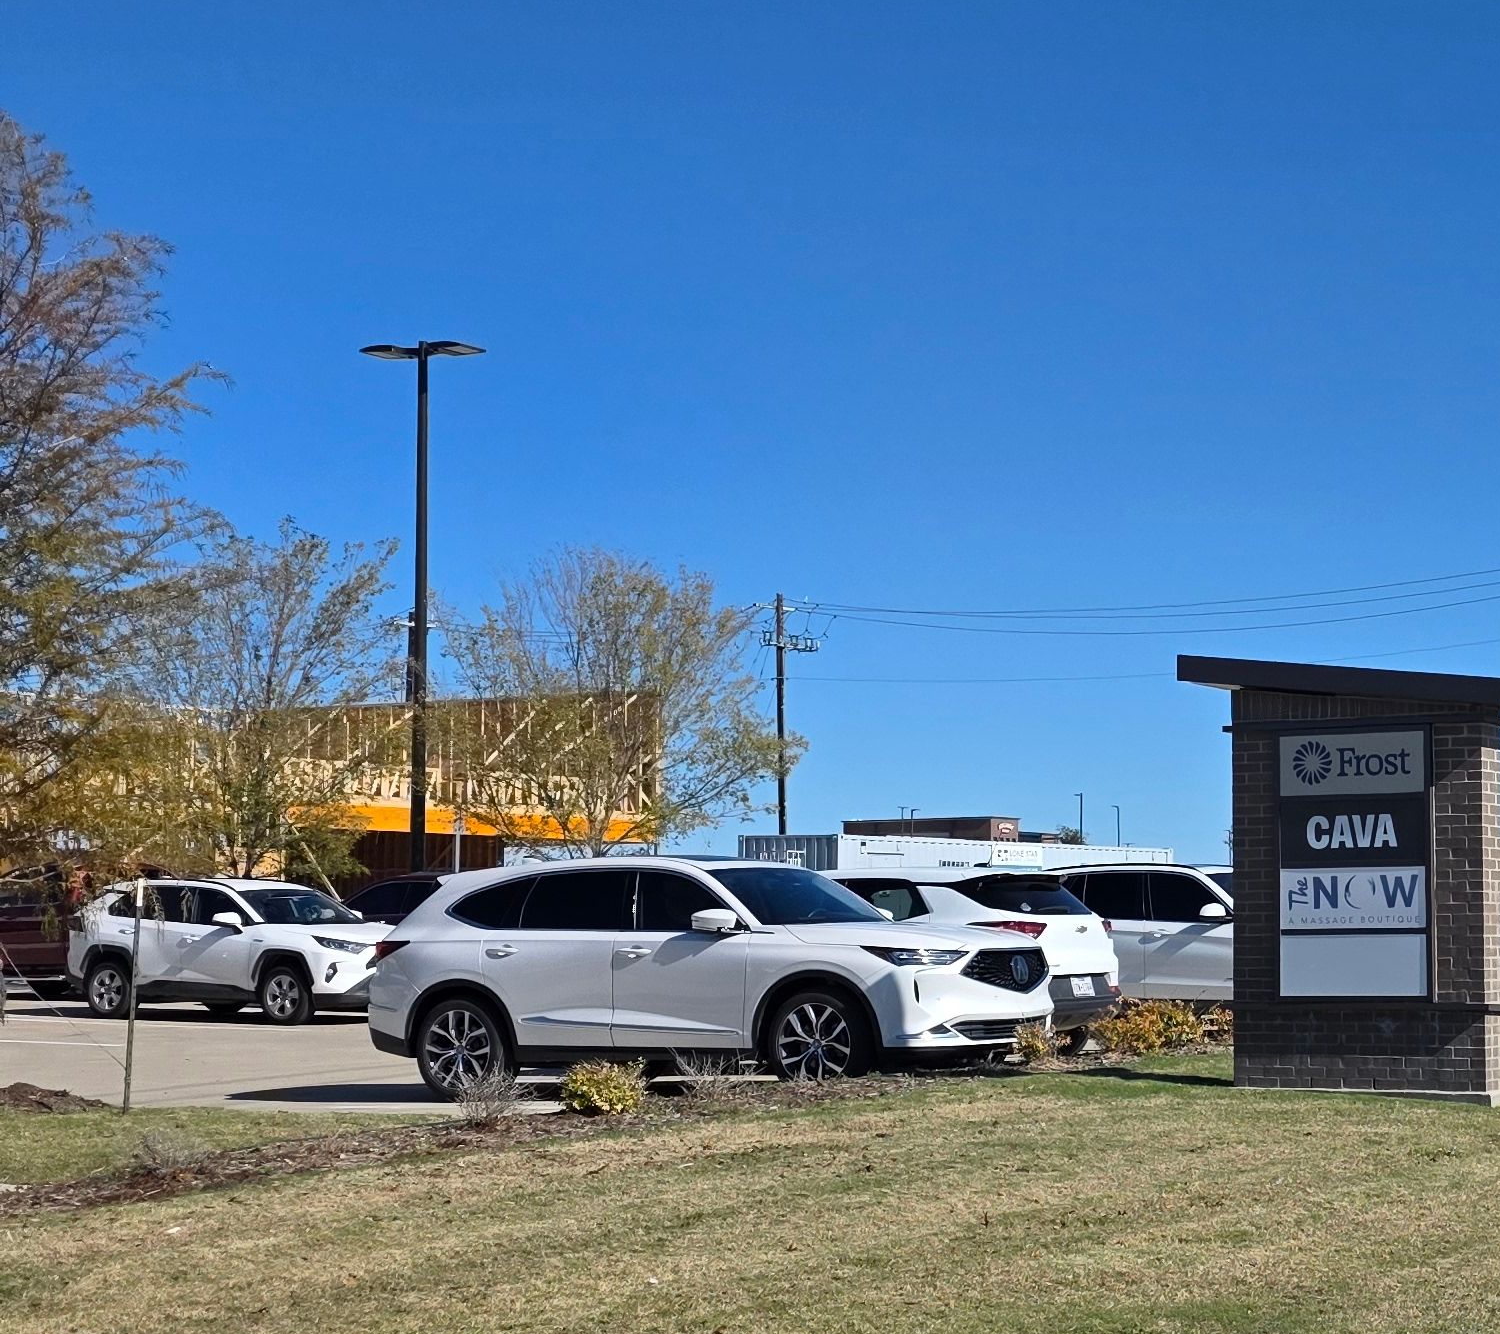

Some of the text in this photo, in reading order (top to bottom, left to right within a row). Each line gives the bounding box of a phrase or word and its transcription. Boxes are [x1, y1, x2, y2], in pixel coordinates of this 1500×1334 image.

[1336, 747, 1411, 777] Frost
[1306, 813, 1398, 850] CAVA
[1288, 873, 1419, 911] The NOW
[1288, 915, 1422, 925] A MASSAGE BOUTIQUE
